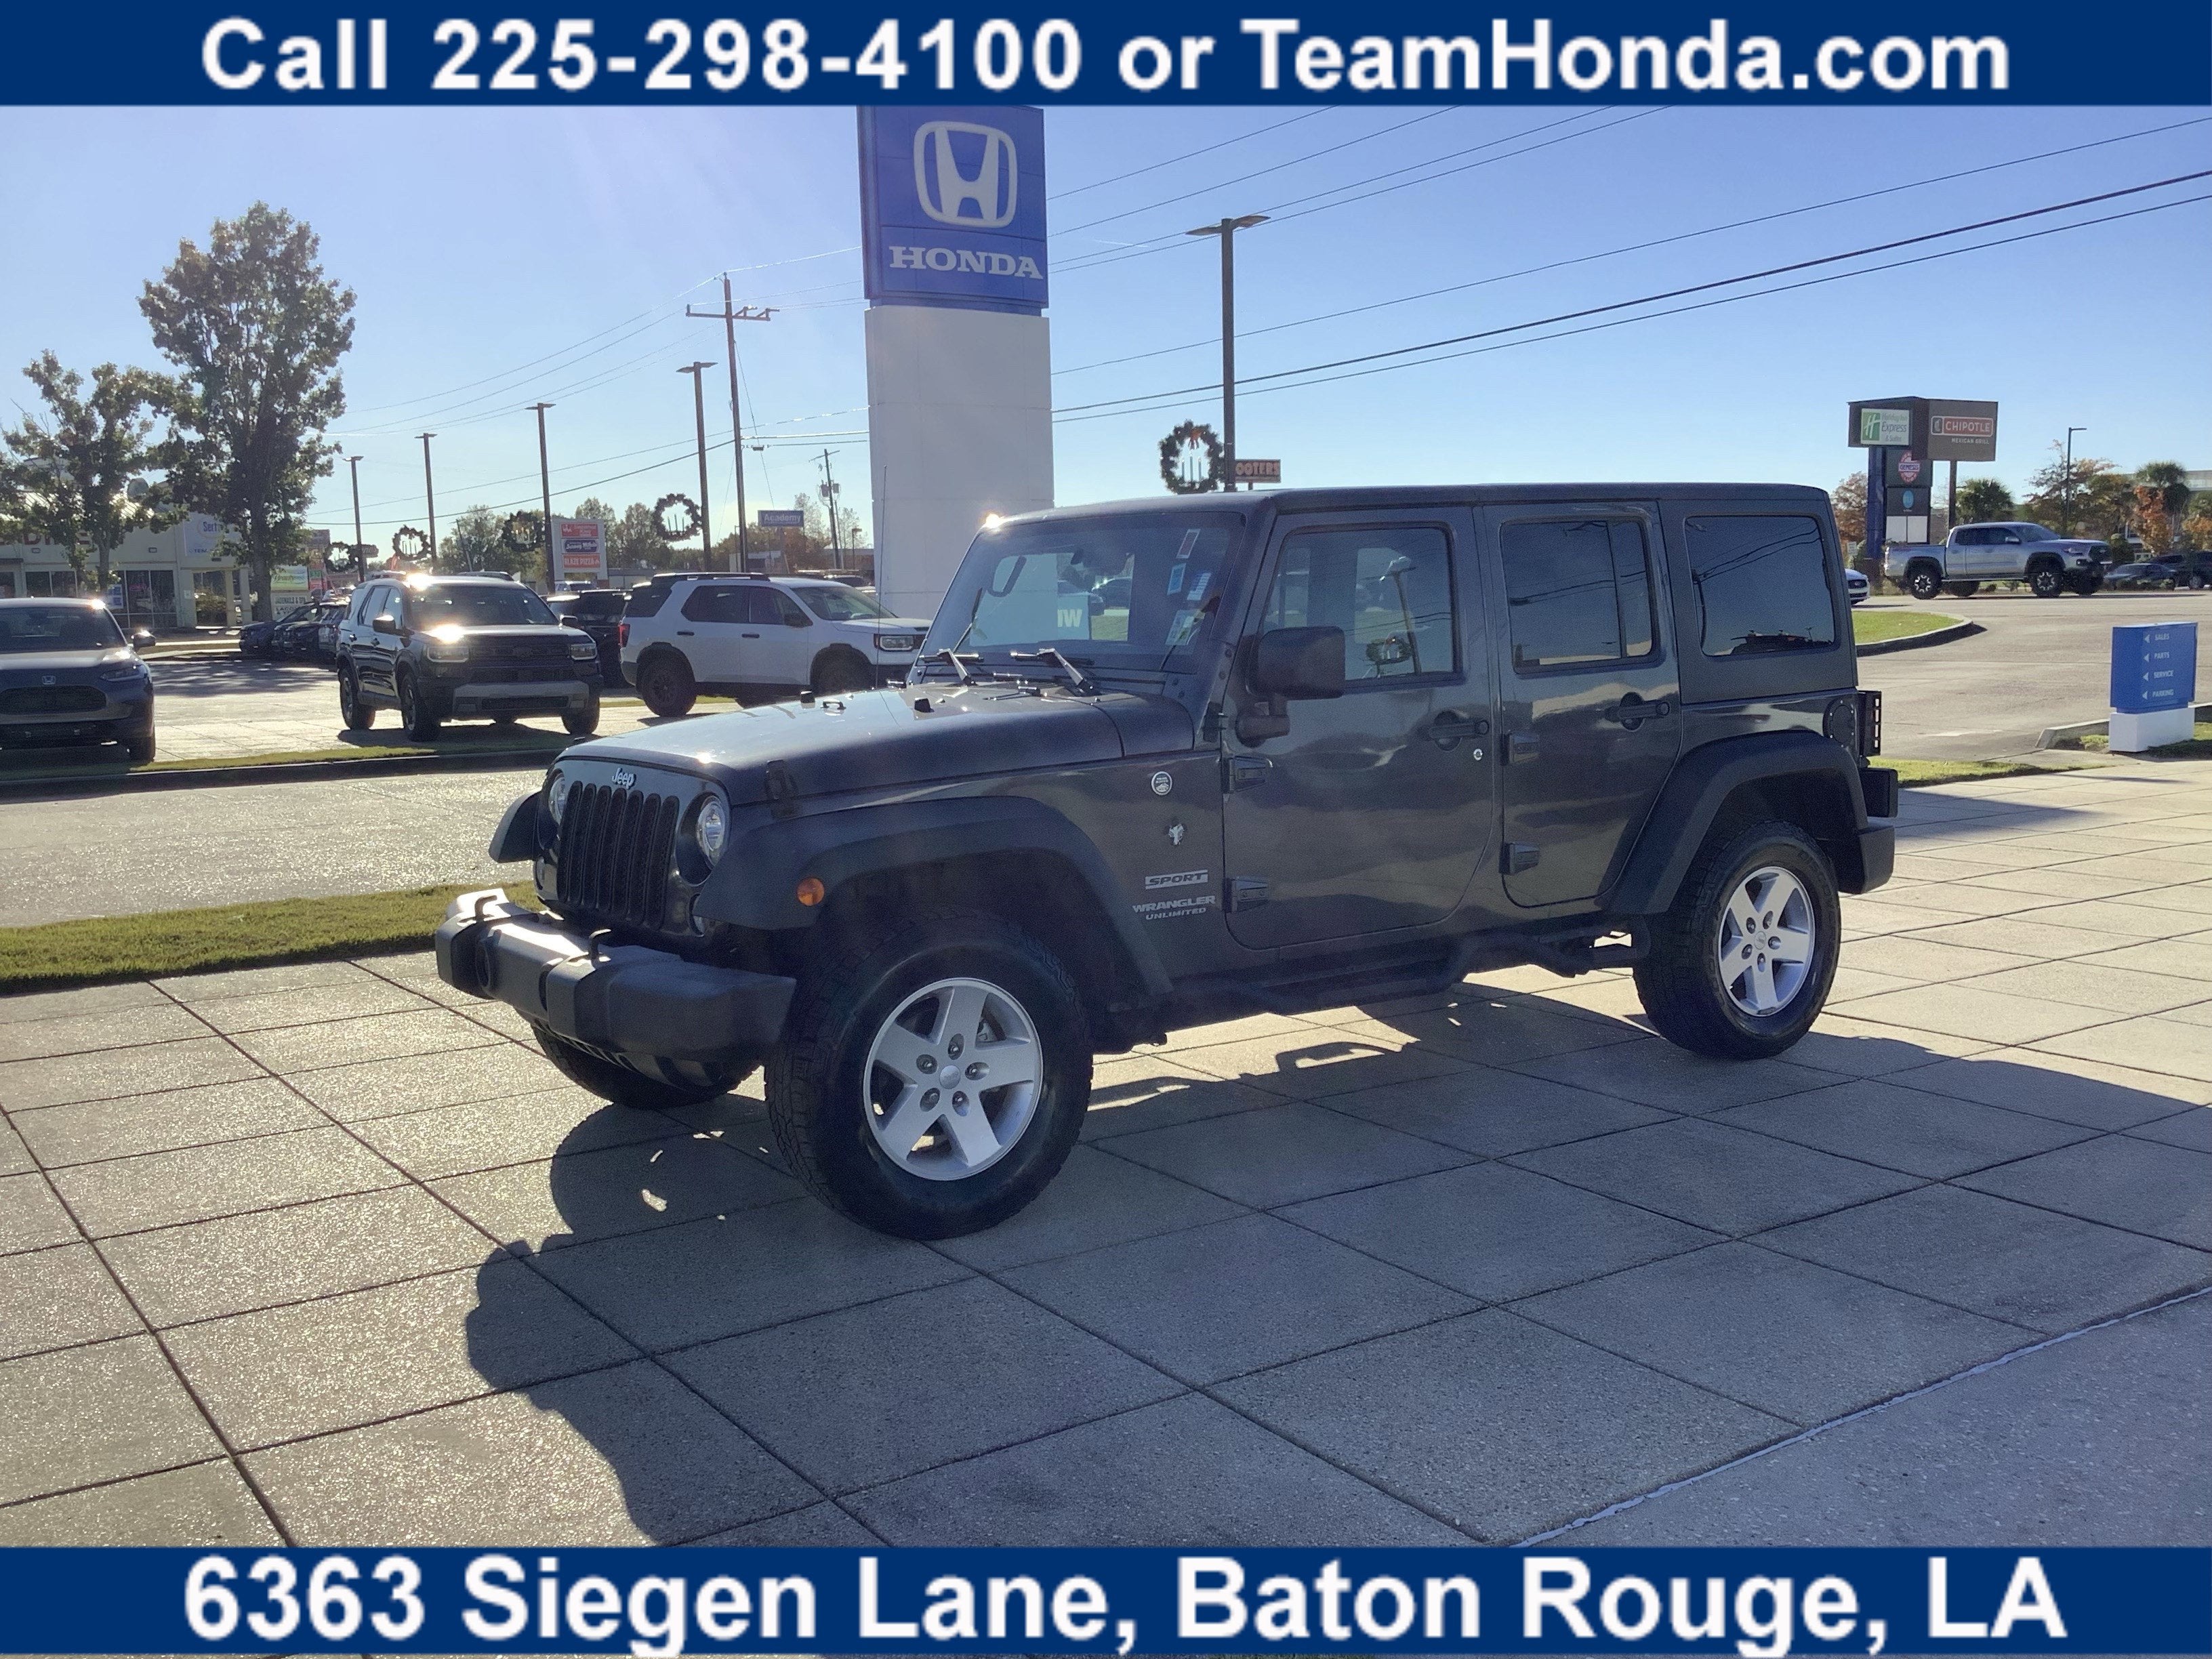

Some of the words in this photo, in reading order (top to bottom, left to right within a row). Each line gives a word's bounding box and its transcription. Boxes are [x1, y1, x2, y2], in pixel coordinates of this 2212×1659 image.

[889, 246, 1043, 279] HONDA
[1882, 421, 1907, 434] Express
[1945, 421, 1990, 432] CHIPOTLE
[764, 514, 801, 523] Academy
[2154, 651, 2169, 659] PARTS
[2153, 670, 2174, 679] SERVICE
[2152, 689, 2174, 697] PARKING
[611, 767, 636, 790] Jeep
[1149, 873, 1204, 886] SPORT
[1132, 895, 1216, 913] WRANGLER
[1145, 907, 1206, 920] UNLIMITED
